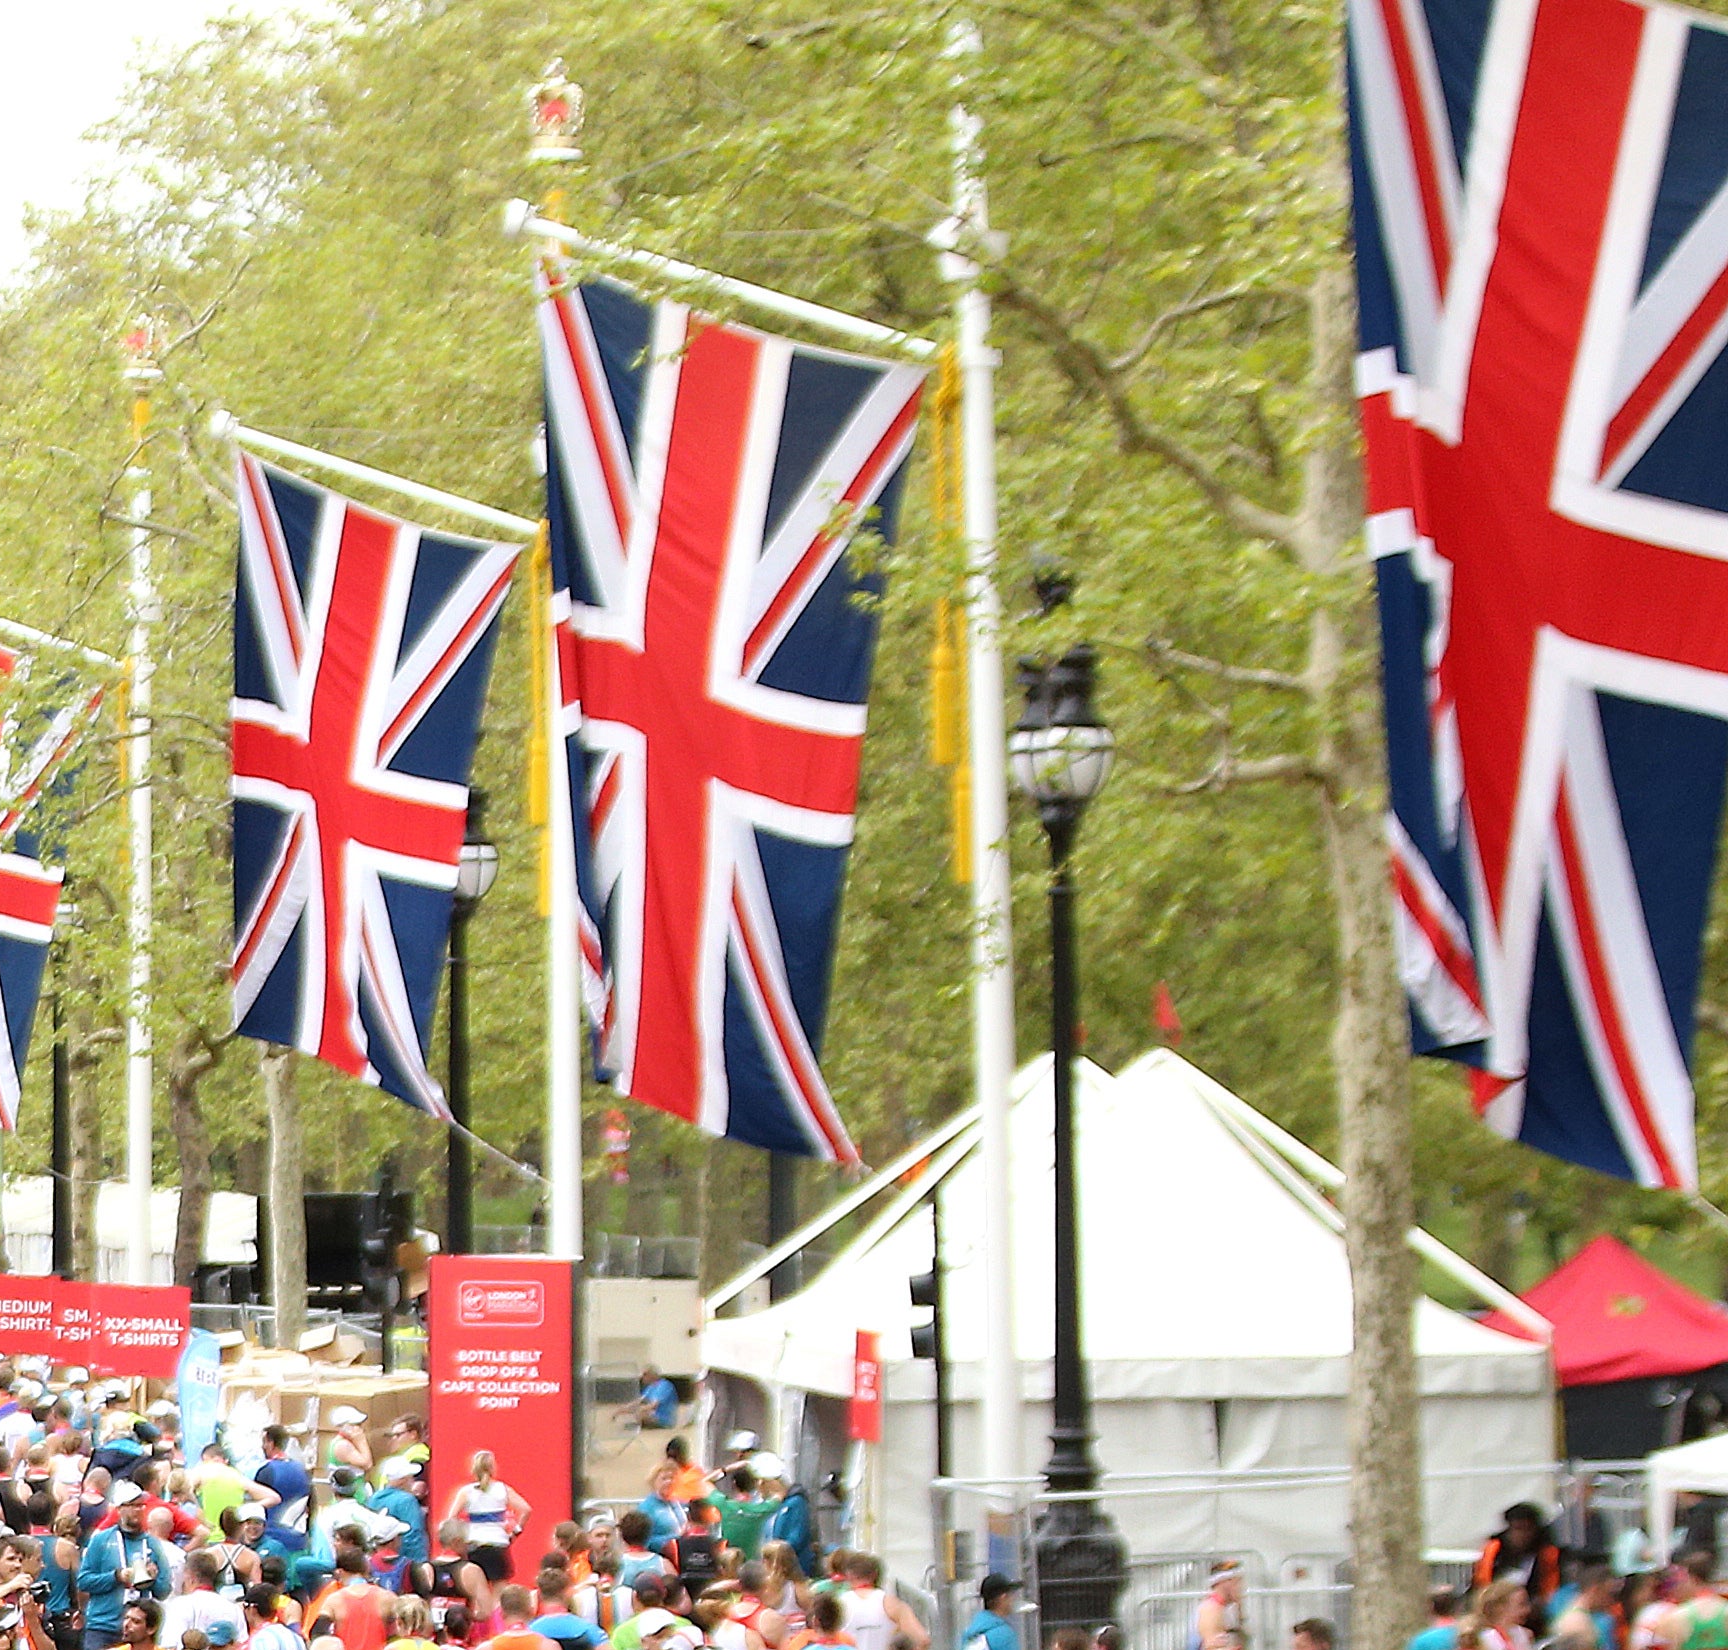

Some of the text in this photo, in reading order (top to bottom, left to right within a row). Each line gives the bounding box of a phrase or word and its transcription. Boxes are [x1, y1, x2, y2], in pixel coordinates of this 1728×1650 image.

[104, 1316, 185, 1332] XX-SMALL
[109, 1332, 181, 1346] T-SHIRTS
[457, 1349, 544, 1363] BOTTLE BELT
[458, 1364, 540, 1379] DROP OFF &
[439, 1380, 561, 1395] CAPE COLLECTION
[477, 1395, 522, 1409] POINT
